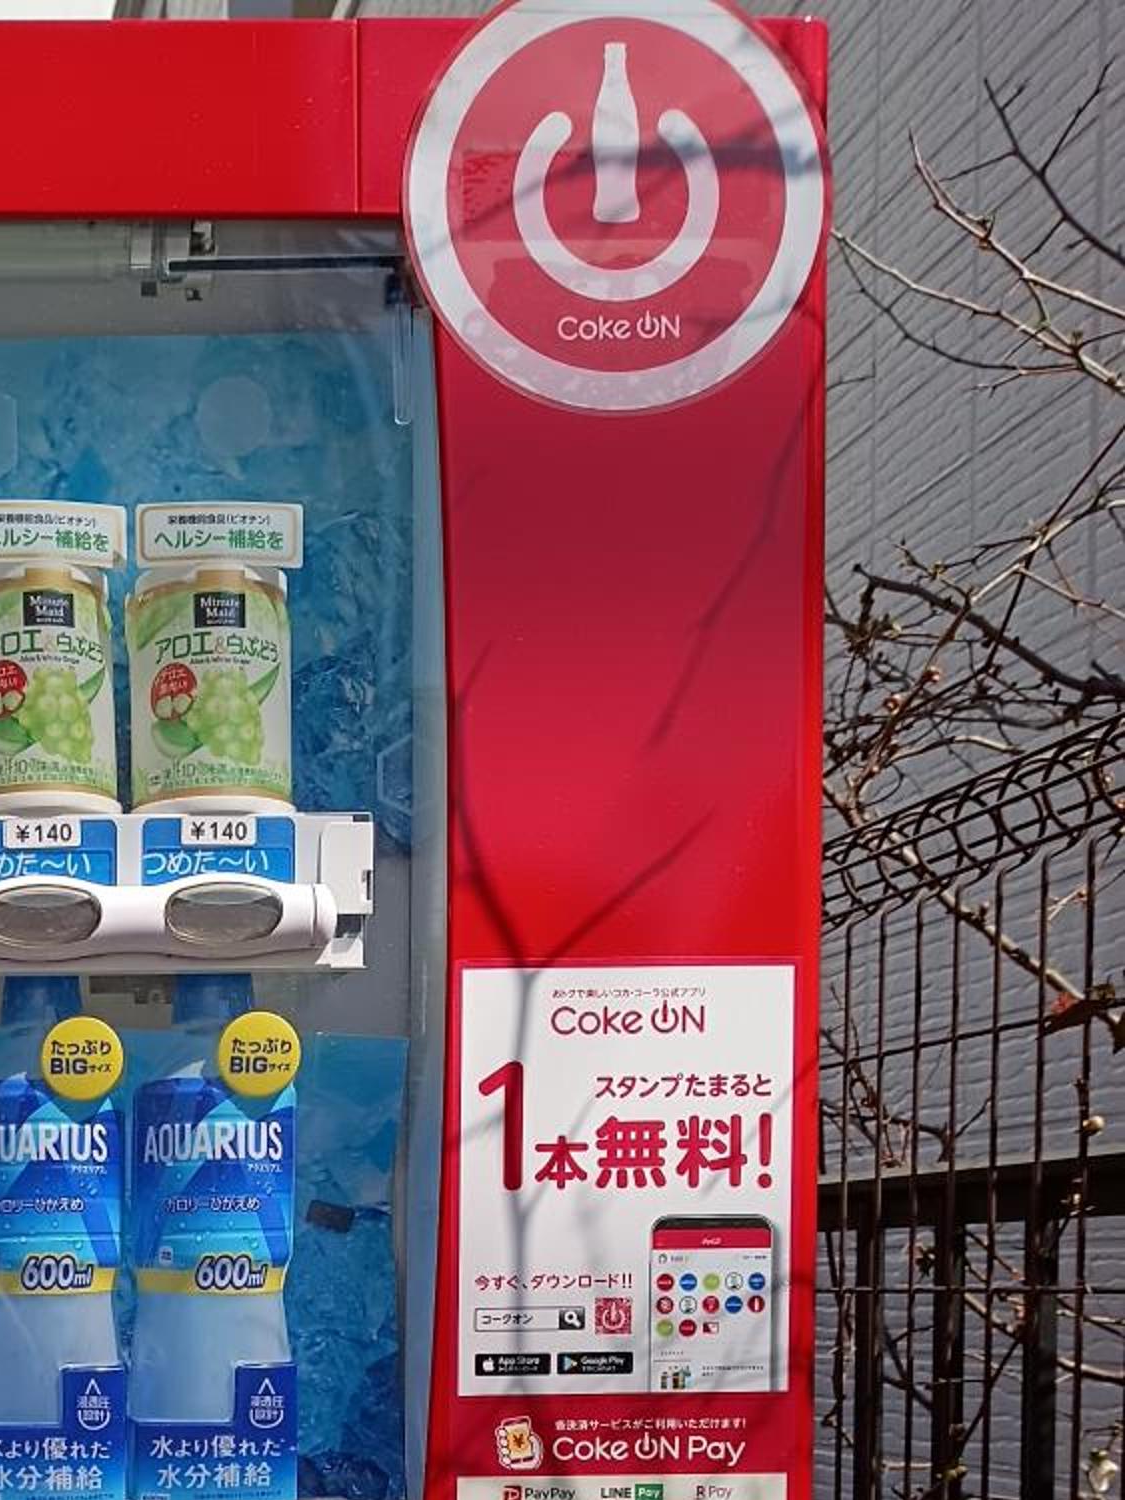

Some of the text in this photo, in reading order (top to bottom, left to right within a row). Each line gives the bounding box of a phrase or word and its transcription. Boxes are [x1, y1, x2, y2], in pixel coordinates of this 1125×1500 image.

[557, 311, 679, 341] Coke ON
[550, 999, 706, 1035] Coke ON
[49, 1039, 112, 1057] たっぷり
[594, 1073, 773, 1099] スタンプたまると
[143, 1120, 283, 1164] AQUARIUS
[21, 1254, 95, 1291] 600ml
[195, 1253, 269, 1291] 600ml
[481, 1312, 534, 1326] コークオン
[552, 1432, 747, 1467] Coke ON Pay
[156, 1462, 273, 1490] 水分補給
[524, 1487, 576, 1500] PayPay
[600, 1486, 662, 1500] LINE Pay
[707, 1485, 733, 1500] Pay
